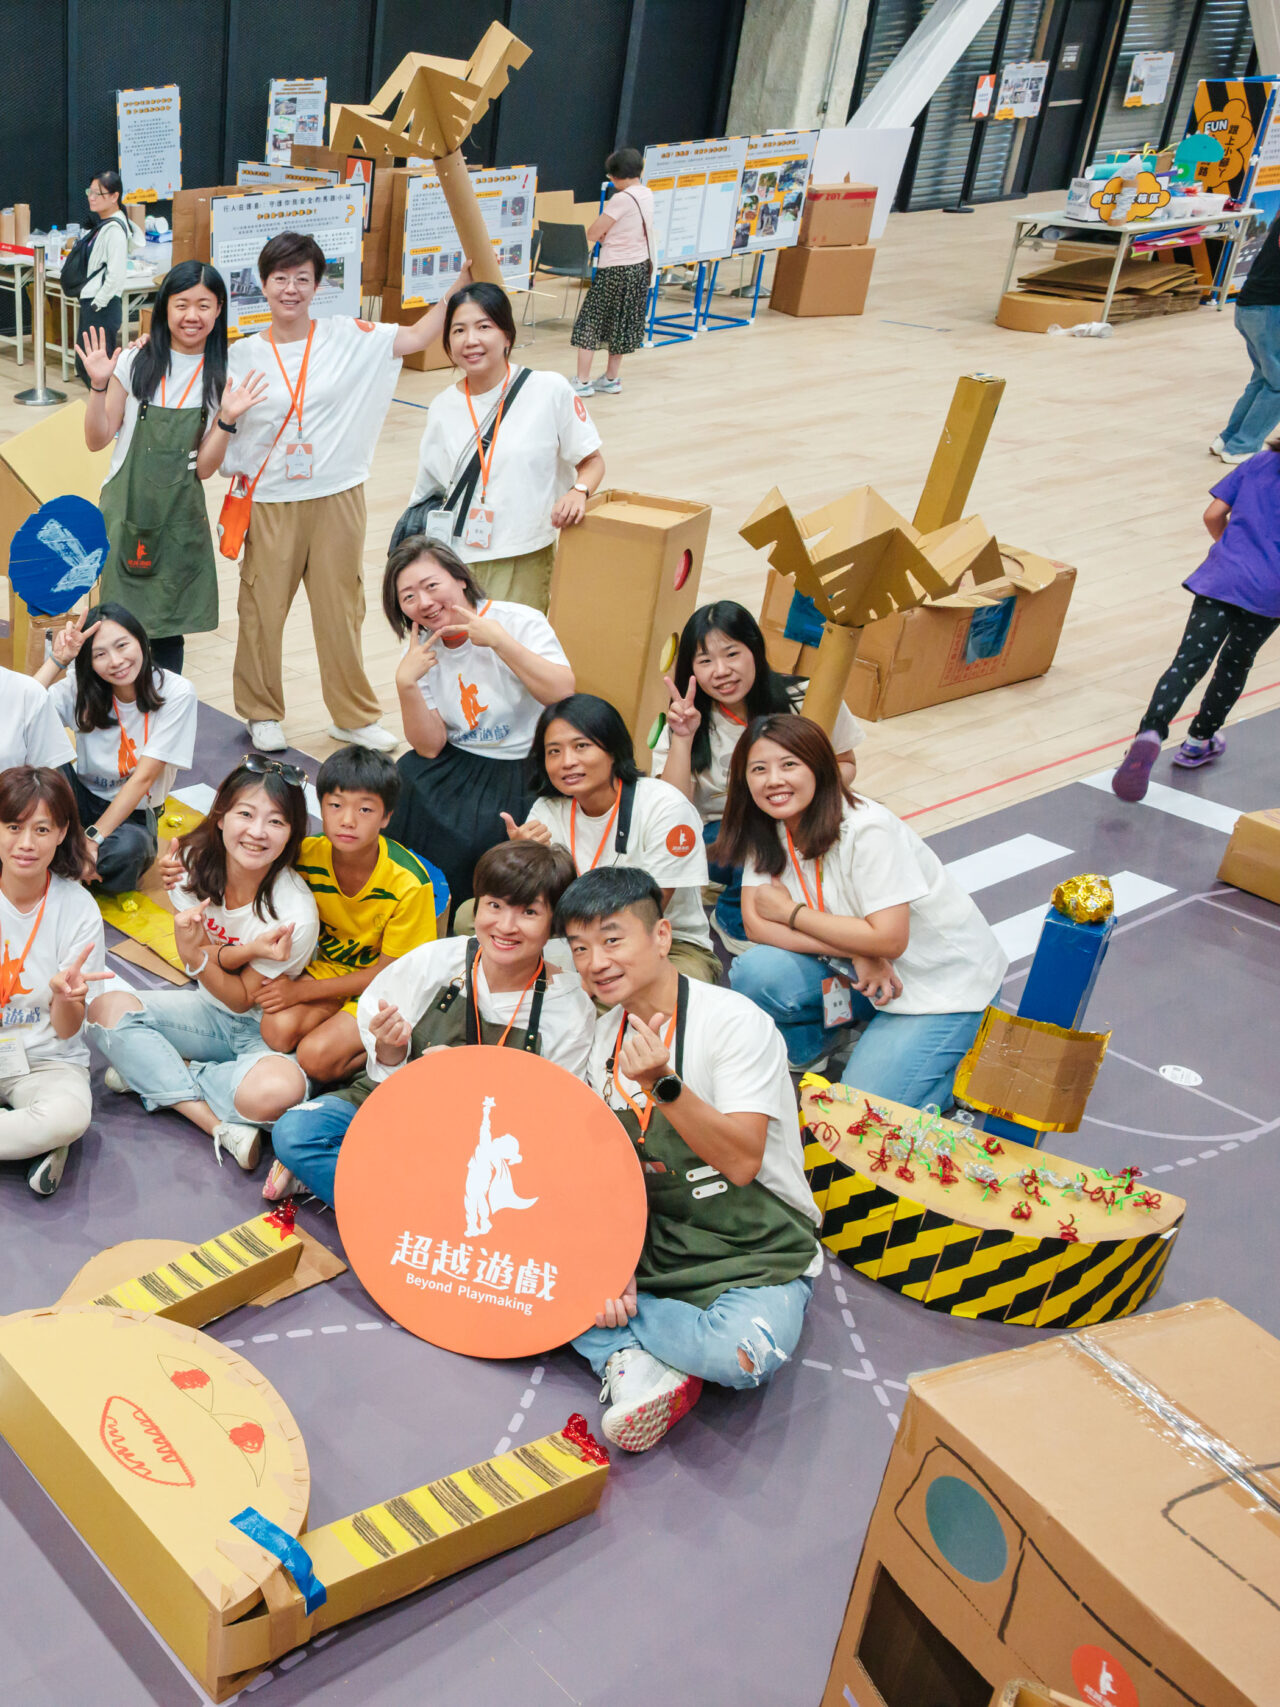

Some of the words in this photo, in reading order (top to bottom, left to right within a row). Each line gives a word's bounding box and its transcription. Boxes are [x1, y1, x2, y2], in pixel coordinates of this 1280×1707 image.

[1204, 118, 1228, 132] FUN
[390, 1230, 559, 1302] 超越遊戲
[405, 1272, 453, 1294] Beyond
[457, 1285, 534, 1316] Playmaking
